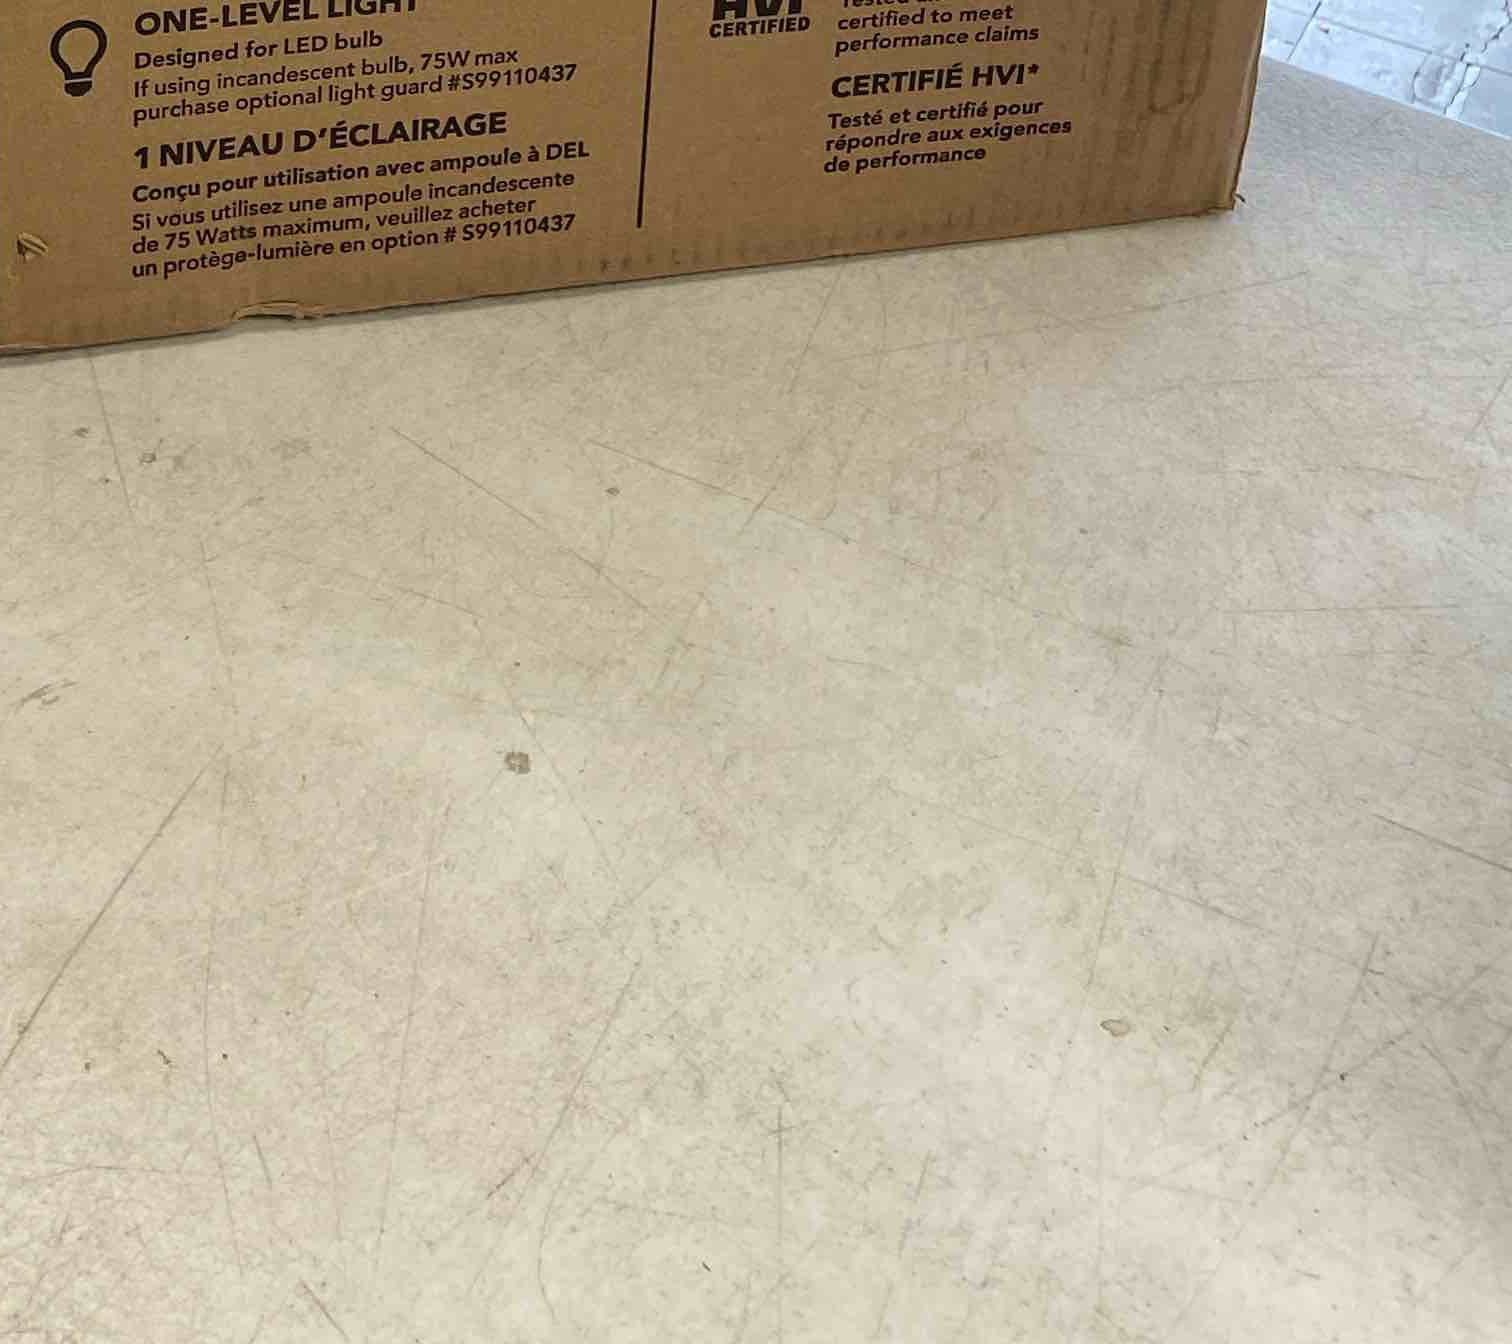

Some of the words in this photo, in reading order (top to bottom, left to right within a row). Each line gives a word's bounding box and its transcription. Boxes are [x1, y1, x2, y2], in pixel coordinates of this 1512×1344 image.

[709, 17, 810, 38] CERTIFIED
[838, 8, 925, 30] certified
[931, 10, 952, 23] to
[960, 5, 1013, 22] meet
[135, 42, 238, 69] Designed
[245, 40, 278, 58] for
[284, 36, 328, 54] LED
[335, 30, 383, 50] bulb
[835, 33, 968, 57] performance
[975, 26, 1039, 42] claims
[135, 79, 149, 98] If
[155, 77, 210, 96] using
[217, 63, 355, 88] incandescent
[362, 56, 414, 75] bulb,
[421, 50, 470, 70] 75W
[475, 50, 517, 66] max
[832, 62, 963, 98] CERTIFIÉ
[134, 99, 229, 128] purchase
[236, 85, 322, 115] optional
[329, 82, 375, 105] light
[381, 75, 442, 101] guard
[448, 64, 576, 91] #S99110437
[828, 109, 882, 129] Testé
[890, 109, 911, 124] et
[916, 101, 988, 121] certifié
[993, 102, 1043, 120] pour
[134, 147, 148, 169] 1
[160, 132, 283, 166] NIVEAU
[826, 128, 921, 153] répondre
[927, 129, 963, 142] aux
[970, 122, 1071, 141] exigences
[133, 184, 200, 202] Conçu
[207, 176, 258, 204] pour
[264, 164, 368, 187] utilisation
[376, 161, 424, 176] avec
[430, 147, 521, 173] ampoule
[528, 146, 539, 162] à
[546, 141, 589, 160] DEL
[824, 156, 850, 173] de
[856, 148, 986, 174] performance
[133, 213, 150, 231] Si
[157, 211, 204, 227] vous
[212, 200, 283, 221] utilisez
[289, 198, 327, 212] une
[333, 184, 422, 211] ampoule
[428, 173, 574, 199] incandescente
[133, 236, 159, 254] de
[165, 232, 190, 250] 75
[196, 225, 256, 245] Watts
[263, 218, 370, 237] maximum,
[376, 206, 453, 226] veuillez
[459, 200, 536, 219] acheter
[132, 264, 157, 277] un
[163, 239, 334, 279] protège-lumière
[340, 240, 365, 253] en
[371, 230, 438, 254] option
[444, 227, 456, 243] #
[462, 213, 575, 242] S99110437
